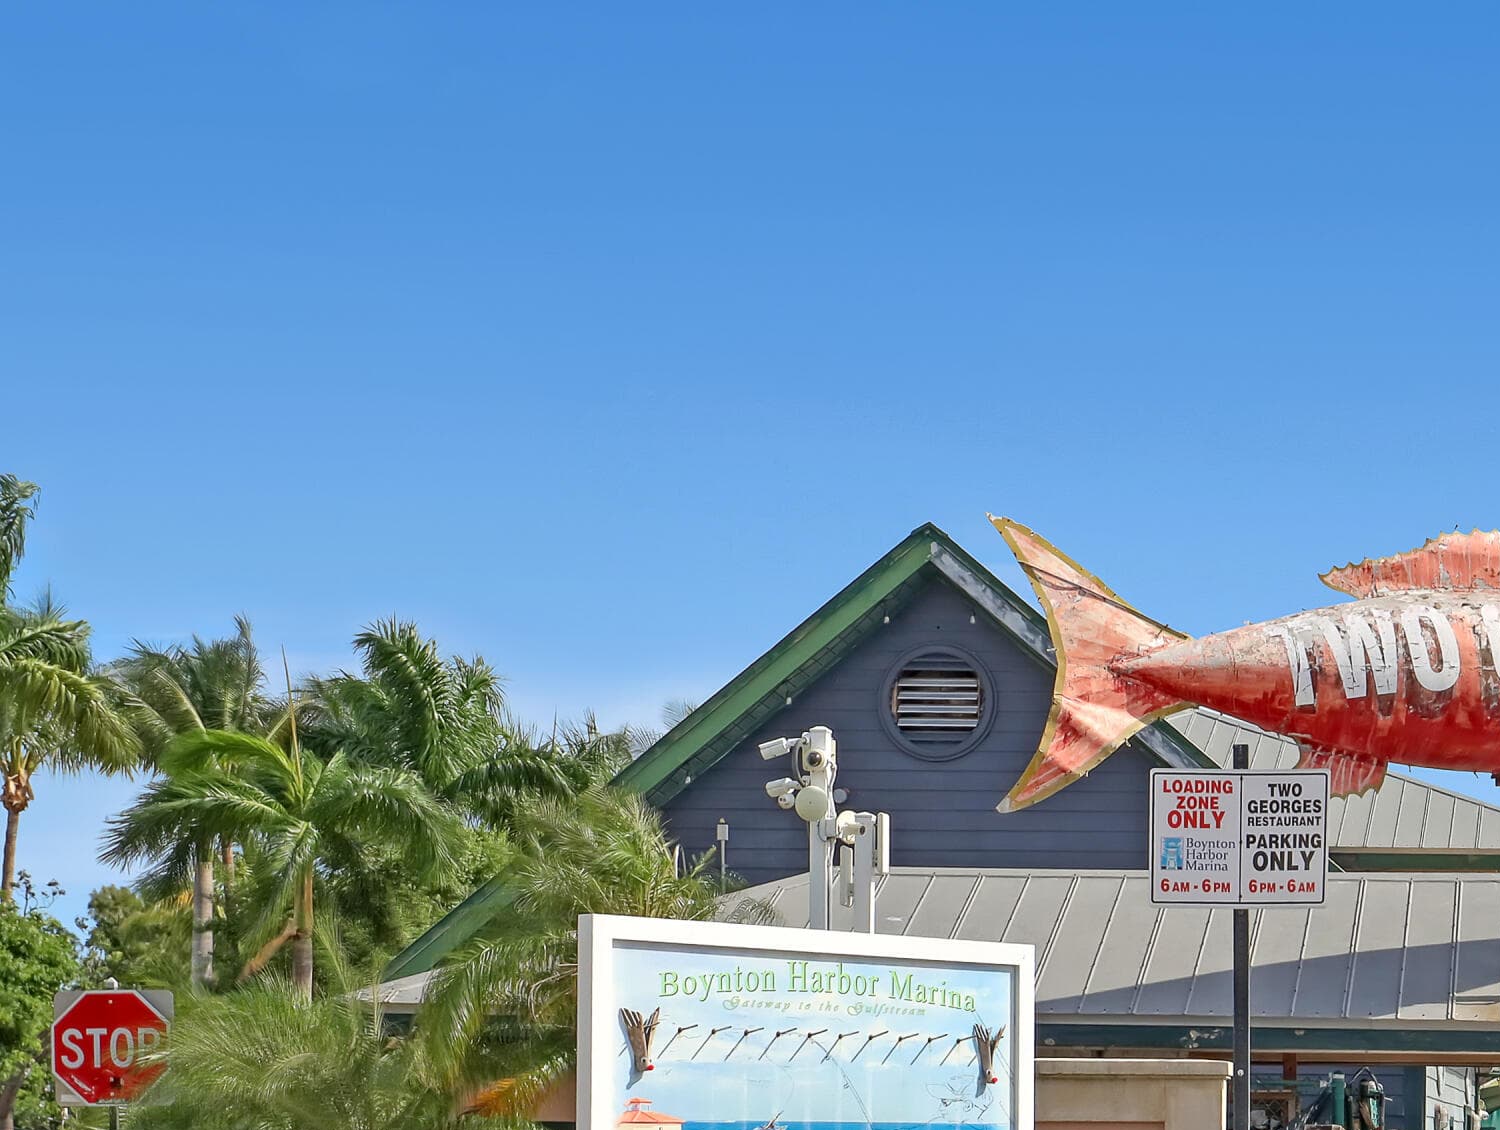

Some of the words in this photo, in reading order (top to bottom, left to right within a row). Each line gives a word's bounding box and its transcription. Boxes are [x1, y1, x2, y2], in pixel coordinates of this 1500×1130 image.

[1267, 604, 1460, 706] TWO
[1163, 779, 1233, 794] LOADING
[1268, 783, 1303, 797] TWO
[1176, 796, 1219, 810] ZONE
[1247, 800, 1322, 813] GEORGES
[1167, 810, 1225, 829] ONLY
[1247, 816, 1322, 827] RESTAURANT
[1186, 837, 1236, 851] Boynton
[1246, 834, 1322, 849] PARKING
[1186, 849, 1228, 860] Harbor
[1252, 851, 1315, 871] ONLY
[1185, 860, 1228, 871] Marina
[1161, 879, 1170, 893] 6
[1172, 882, 1190, 893] AM
[1202, 879, 1211, 893] 6
[1213, 882, 1231, 893] PM
[1249, 879, 1257, 893] 6
[1260, 882, 1276, 893] PM
[1287, 879, 1296, 893] 6
[1298, 882, 1315, 893] AM
[659, 966, 776, 1002] Boynton
[786, 961, 879, 997] Harbor
[888, 970, 977, 1012] Marina
[722, 996, 791, 1012] Gateway
[799, 1002, 811, 1010] to
[819, 1000, 839, 1012] the
[847, 1002, 927, 1017] Gulfstream
[61, 1027, 160, 1069] STOP
